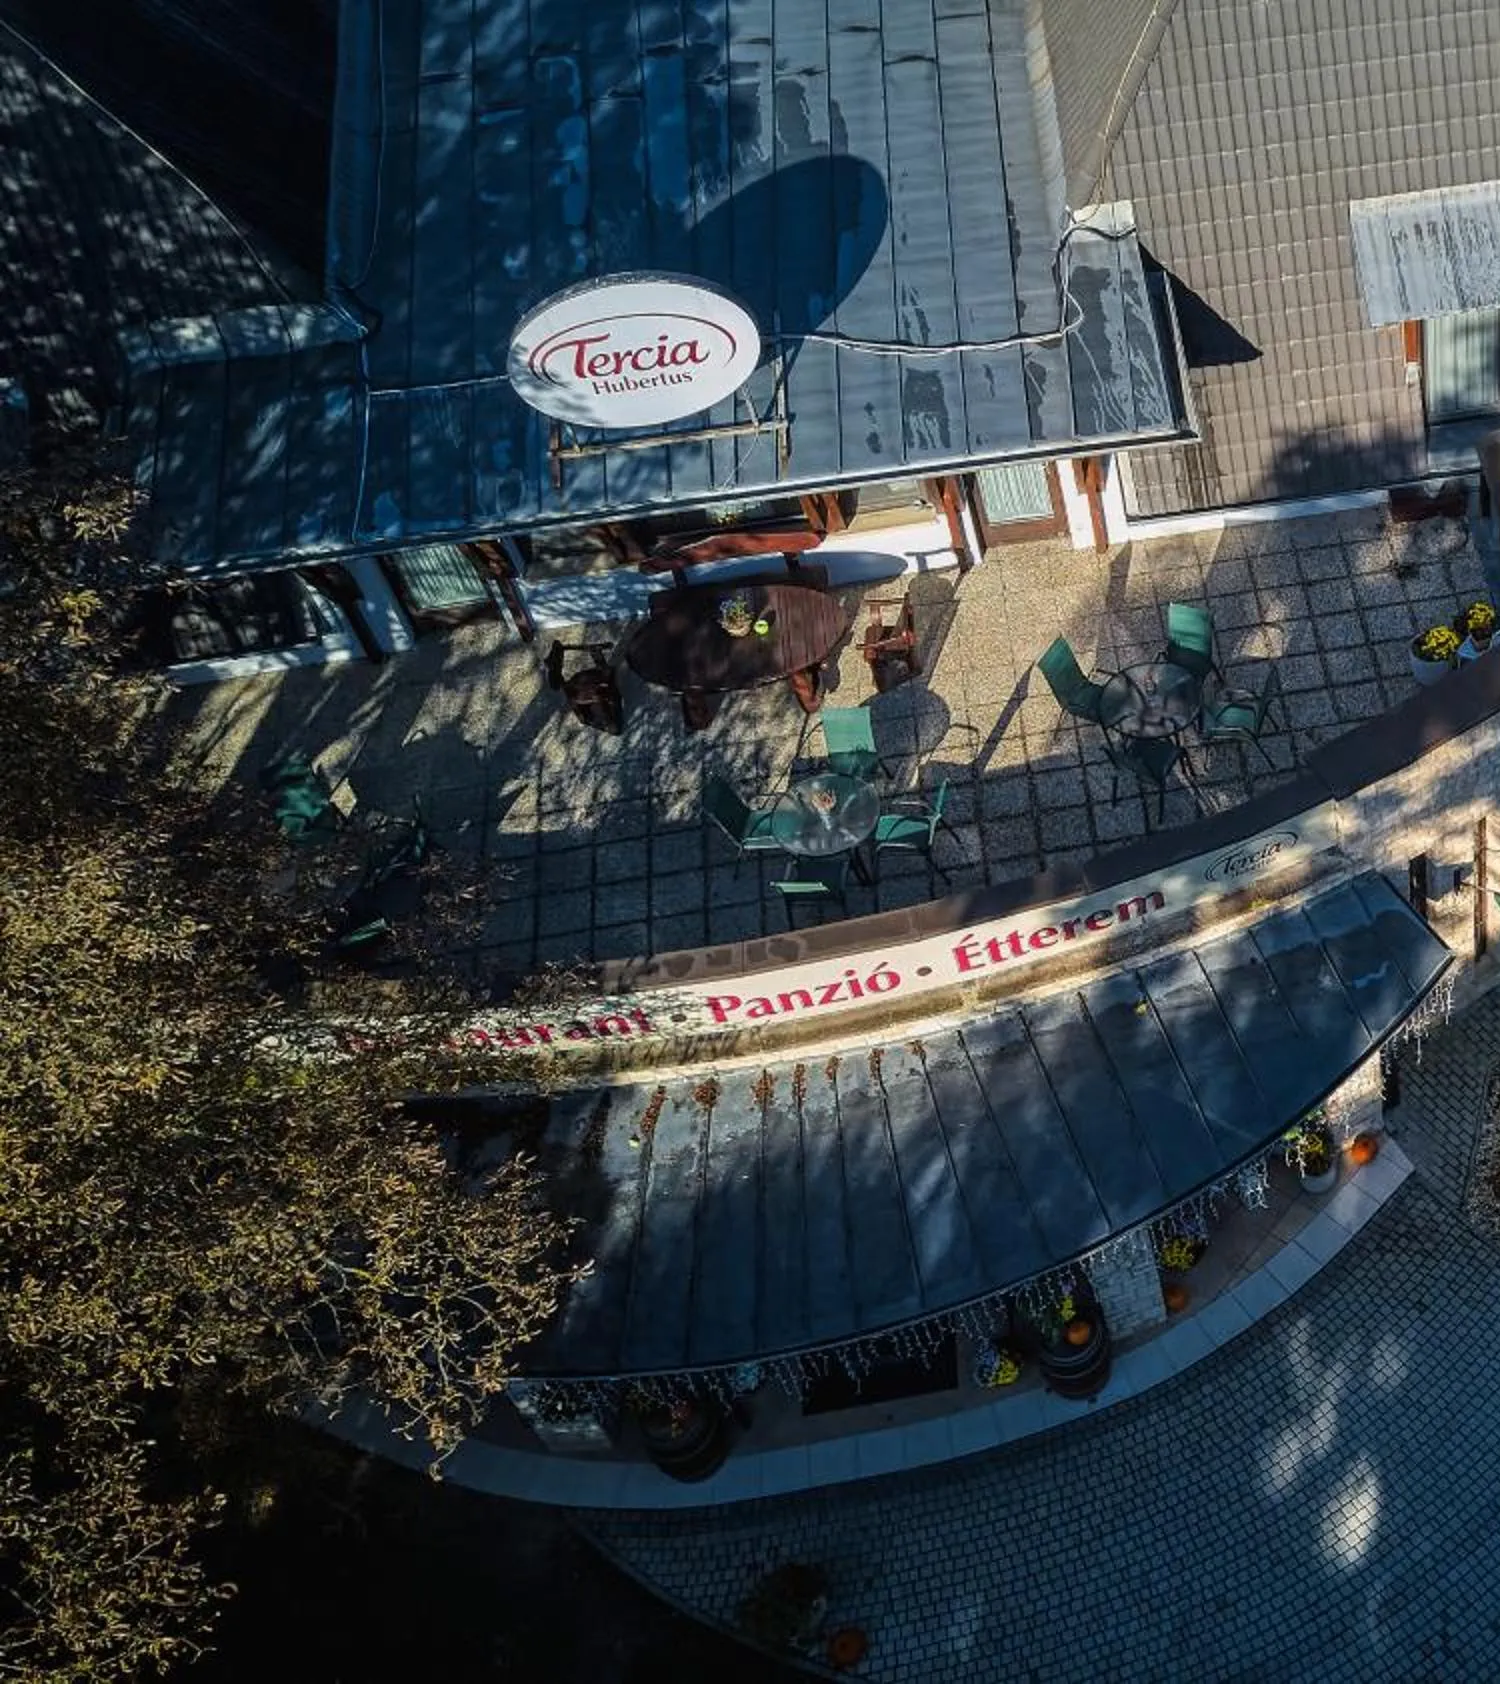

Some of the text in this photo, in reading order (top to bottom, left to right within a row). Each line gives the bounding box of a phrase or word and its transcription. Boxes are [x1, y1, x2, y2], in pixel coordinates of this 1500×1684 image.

[544, 332, 711, 388] Tercia
[592, 371, 694, 395] Hubertus
[705, 961, 902, 1023] Panzió
[952, 890, 1167, 973] Étterem
